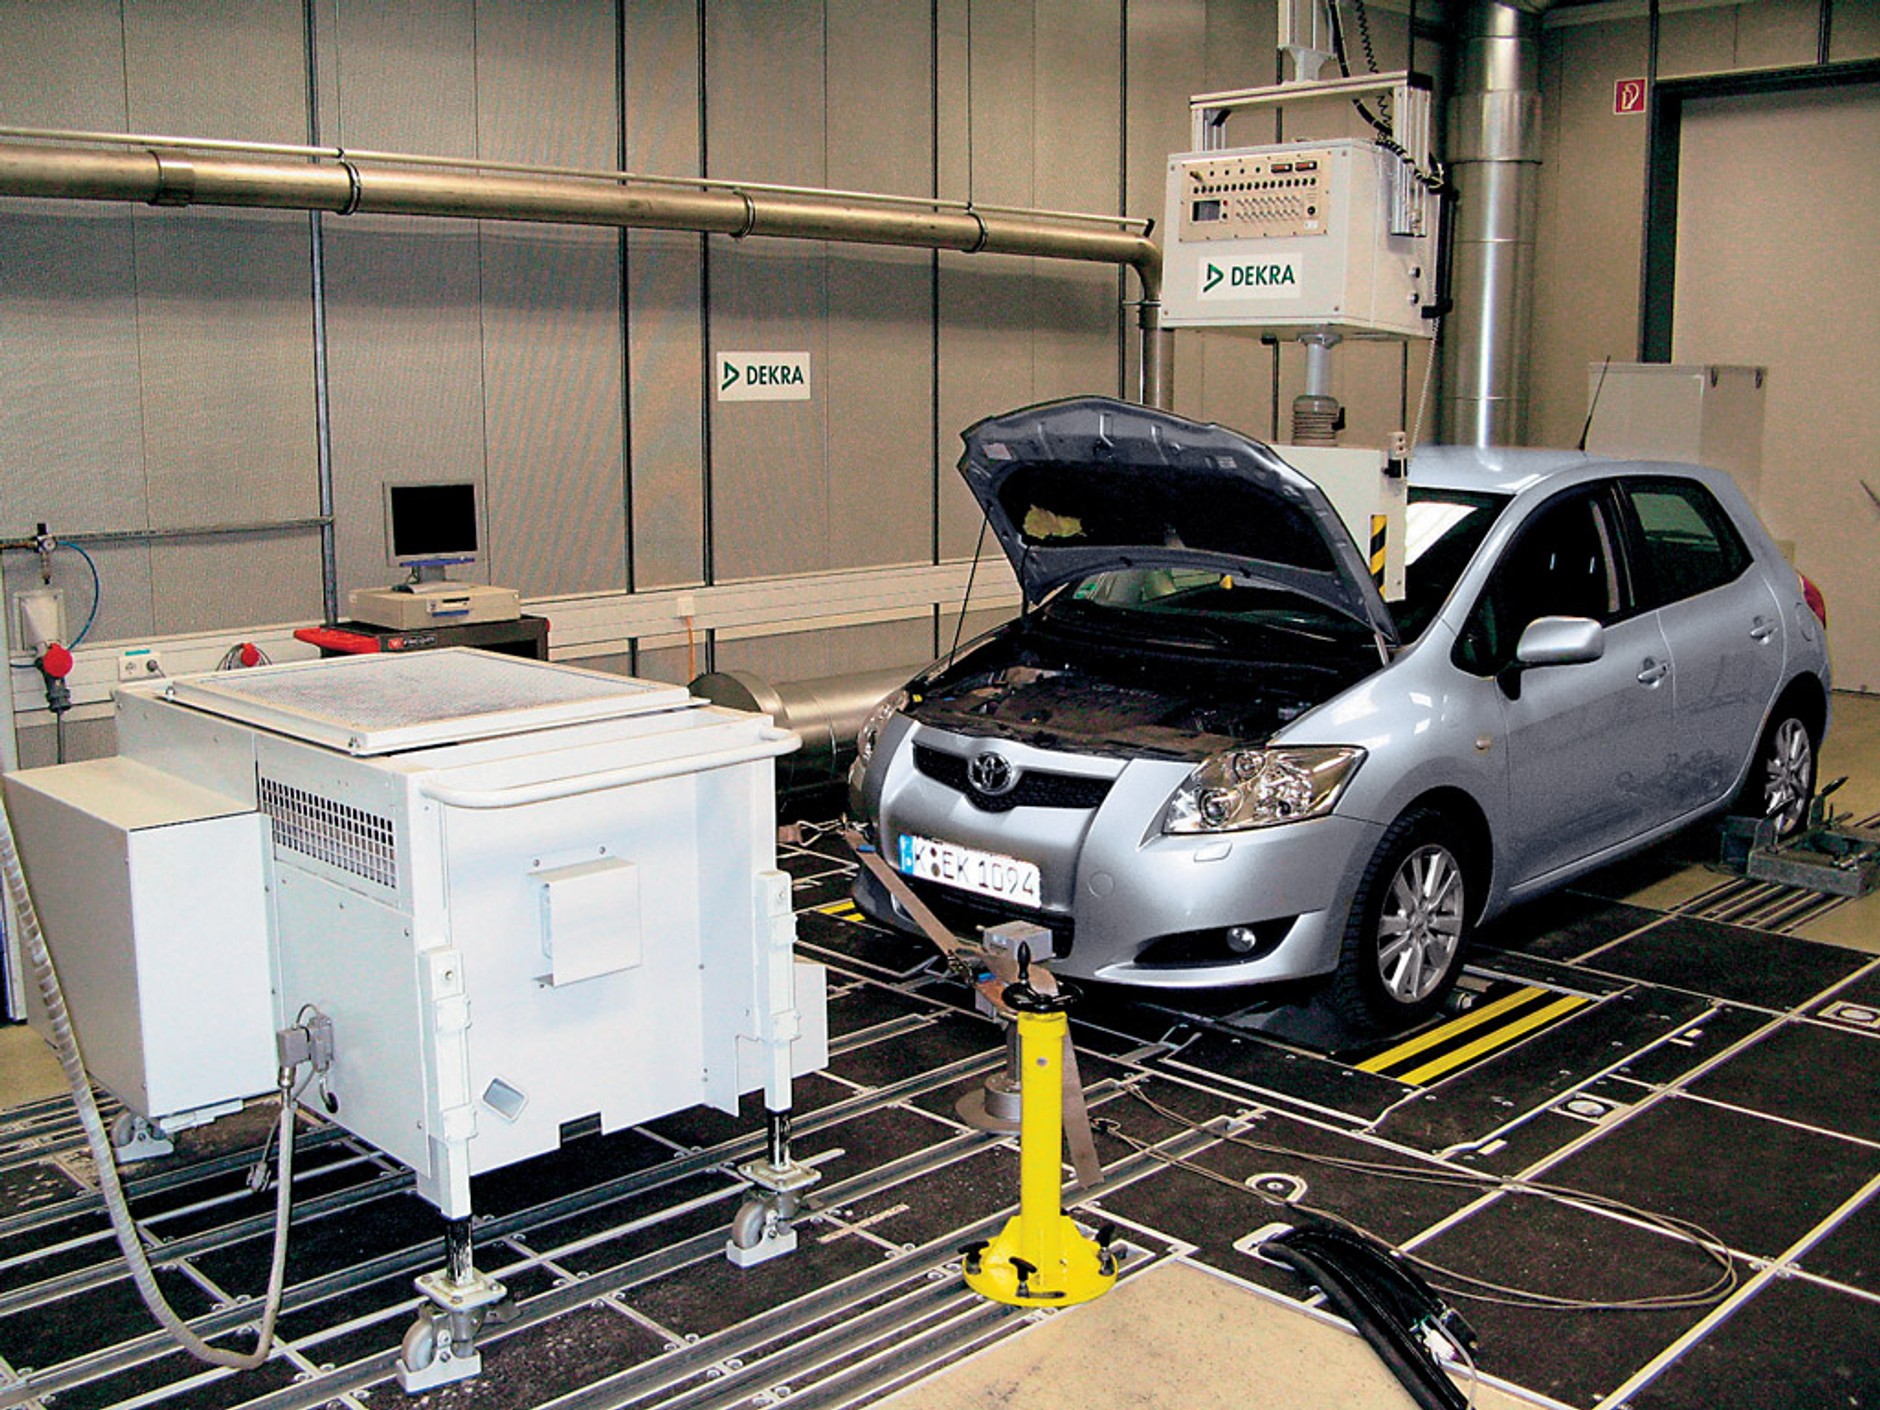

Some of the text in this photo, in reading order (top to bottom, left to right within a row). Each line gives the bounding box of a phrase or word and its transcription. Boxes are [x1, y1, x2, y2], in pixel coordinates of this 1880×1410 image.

[1231, 264, 1296, 286] DEKRA
[746, 365, 804, 385] DEKRA
[978, 860, 1034, 897] 1094
